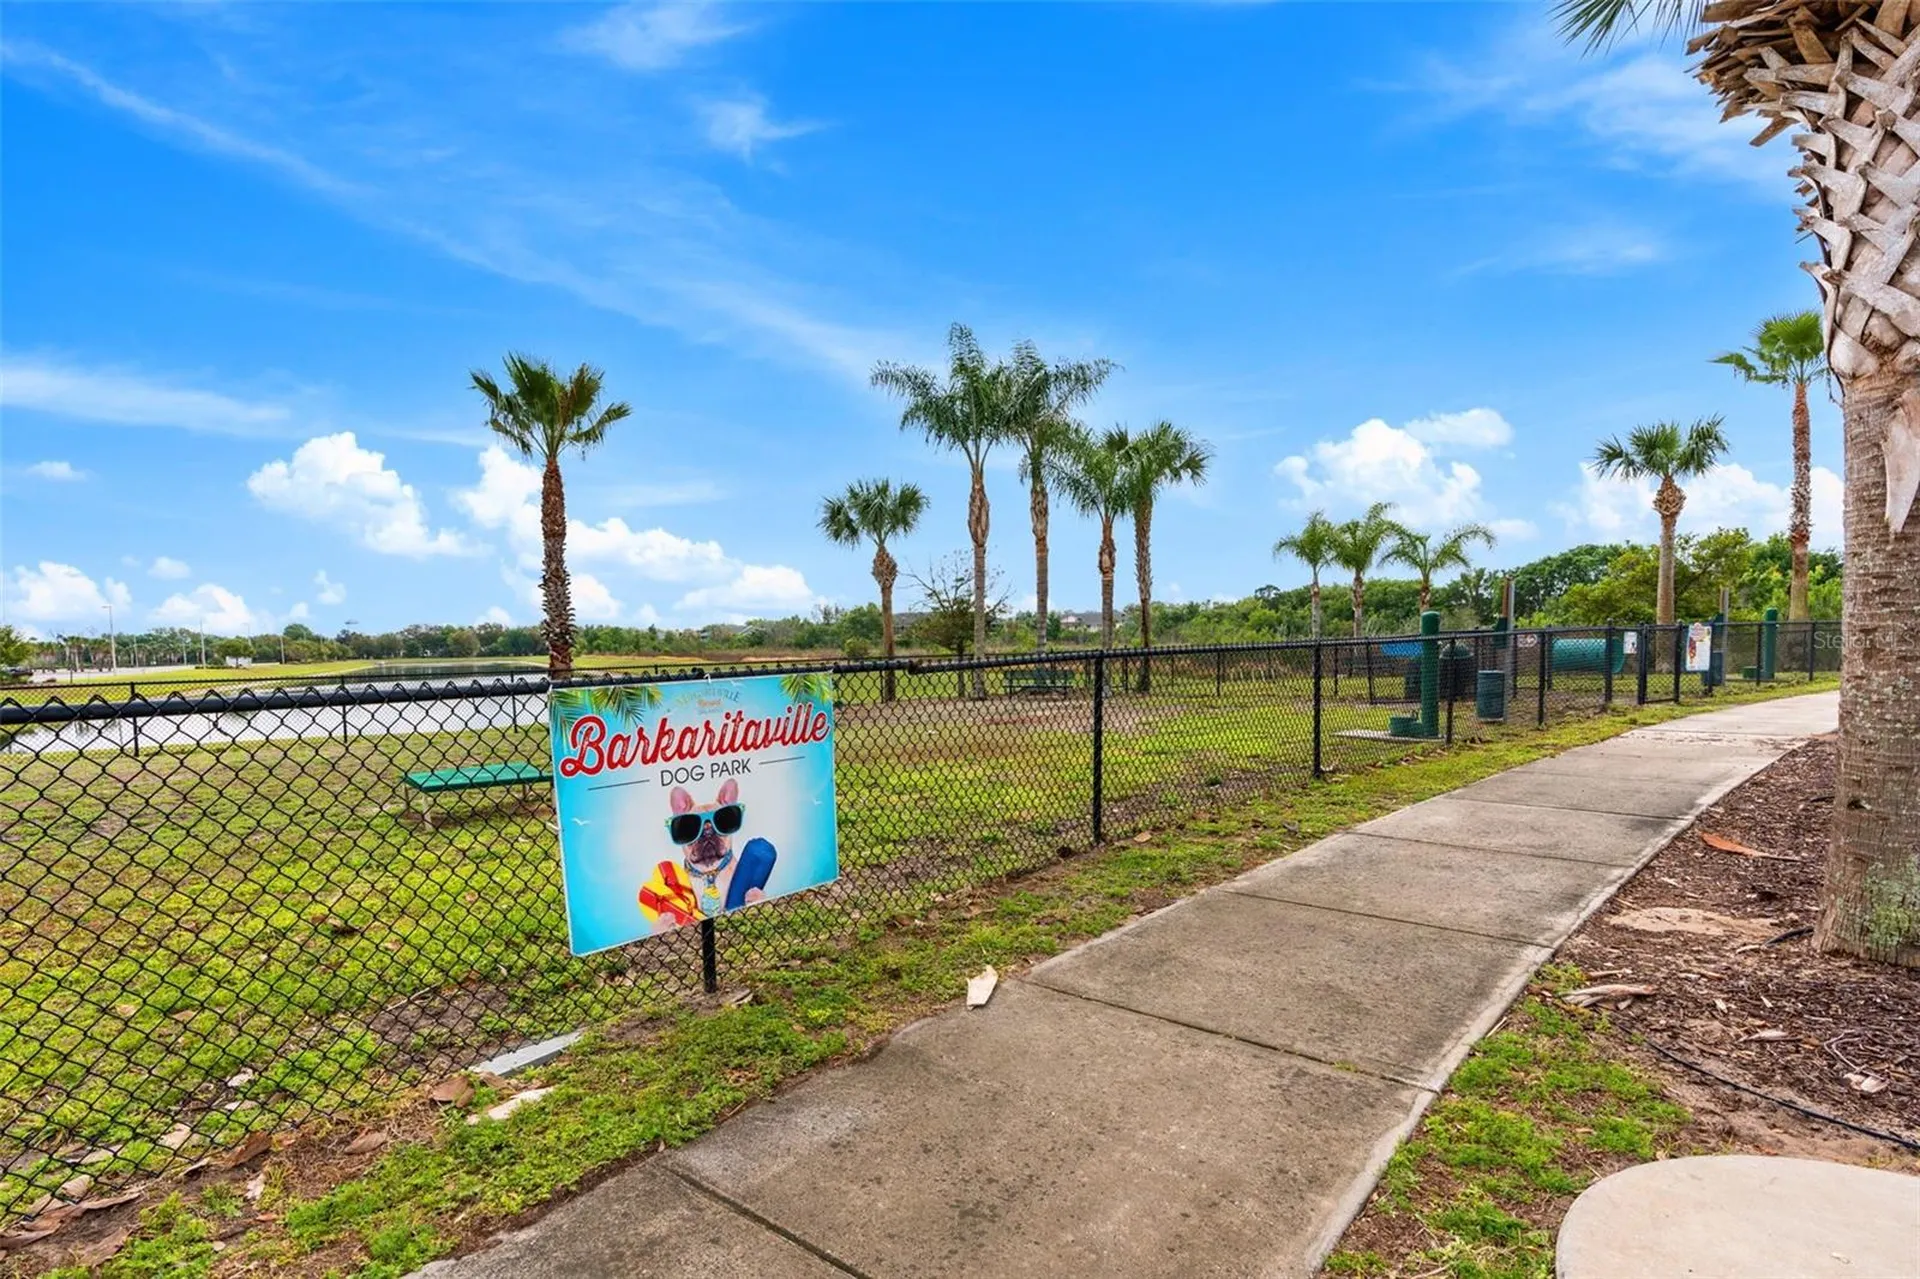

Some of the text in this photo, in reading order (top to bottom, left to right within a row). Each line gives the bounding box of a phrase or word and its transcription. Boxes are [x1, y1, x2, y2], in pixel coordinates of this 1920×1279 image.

[560, 703, 831, 777] Barkaritaville
[660, 757, 752, 787] DOG PARK
